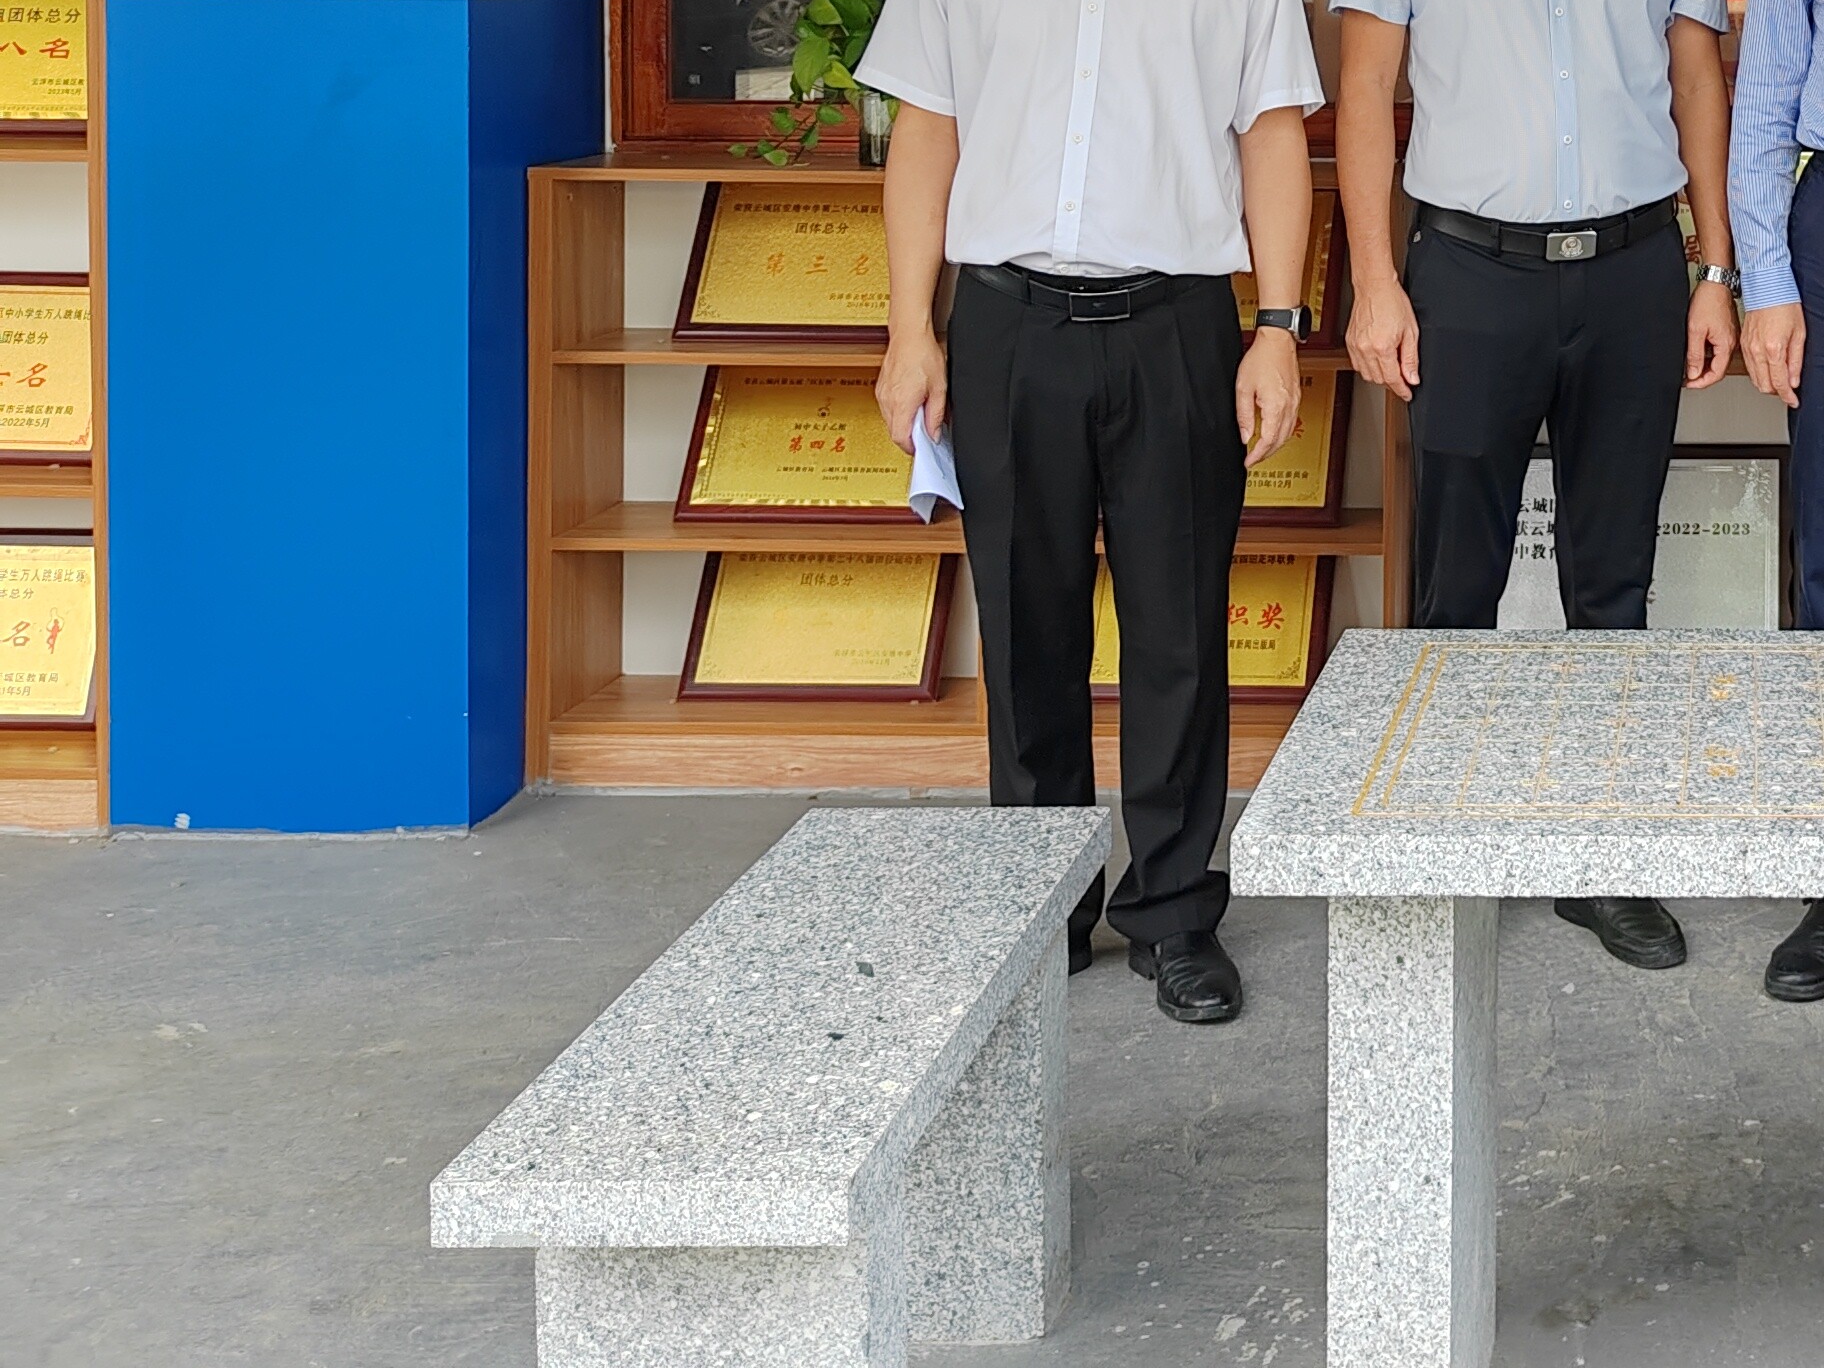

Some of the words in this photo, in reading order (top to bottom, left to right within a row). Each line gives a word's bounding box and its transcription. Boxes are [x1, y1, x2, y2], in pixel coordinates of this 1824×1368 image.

[733, 203, 884, 214] 荣获云城区安塘中学第二十八届田
[795, 222, 850, 235] 团体总分
[766, 252, 871, 277] 第三名
[0, 330, 49, 345] 团体总分
[2, 417, 50, 429] 2022年5月
[789, 435, 846, 454] 第四名
[1656, 522, 1751, 536] 2022-2023
[800, 571, 854, 586] 团体总分
